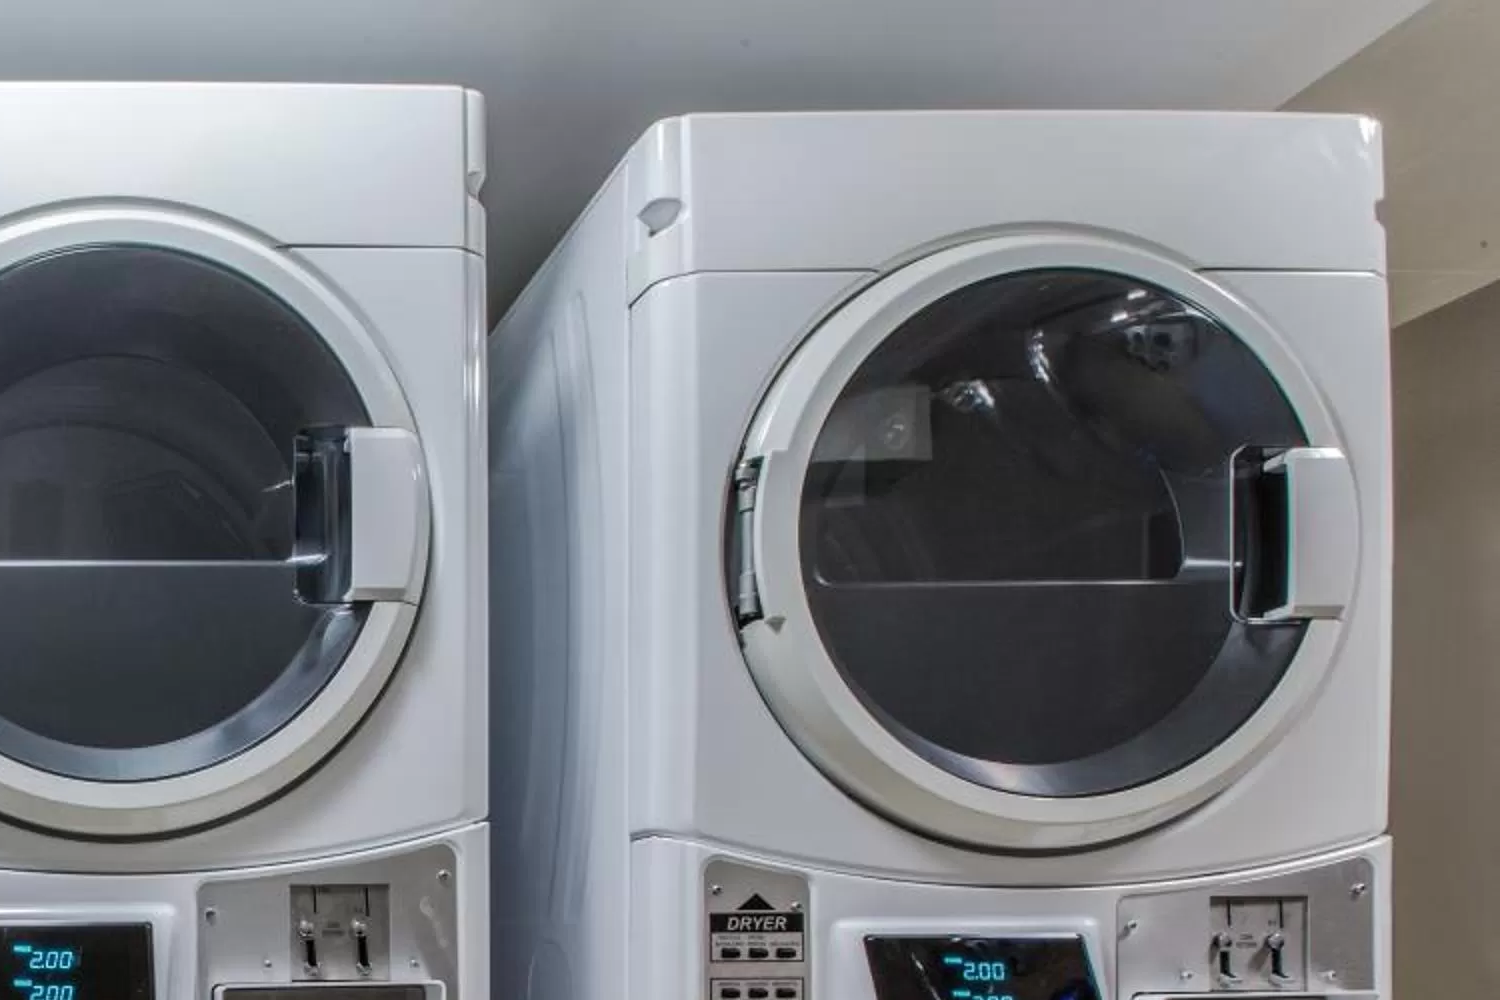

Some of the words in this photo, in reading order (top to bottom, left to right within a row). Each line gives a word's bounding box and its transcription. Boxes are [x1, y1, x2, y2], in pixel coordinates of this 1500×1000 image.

[726, 916, 788, 931] DRYER
[29, 951, 73, 969] 2.00
[963, 962, 1005, 981] 2.00
